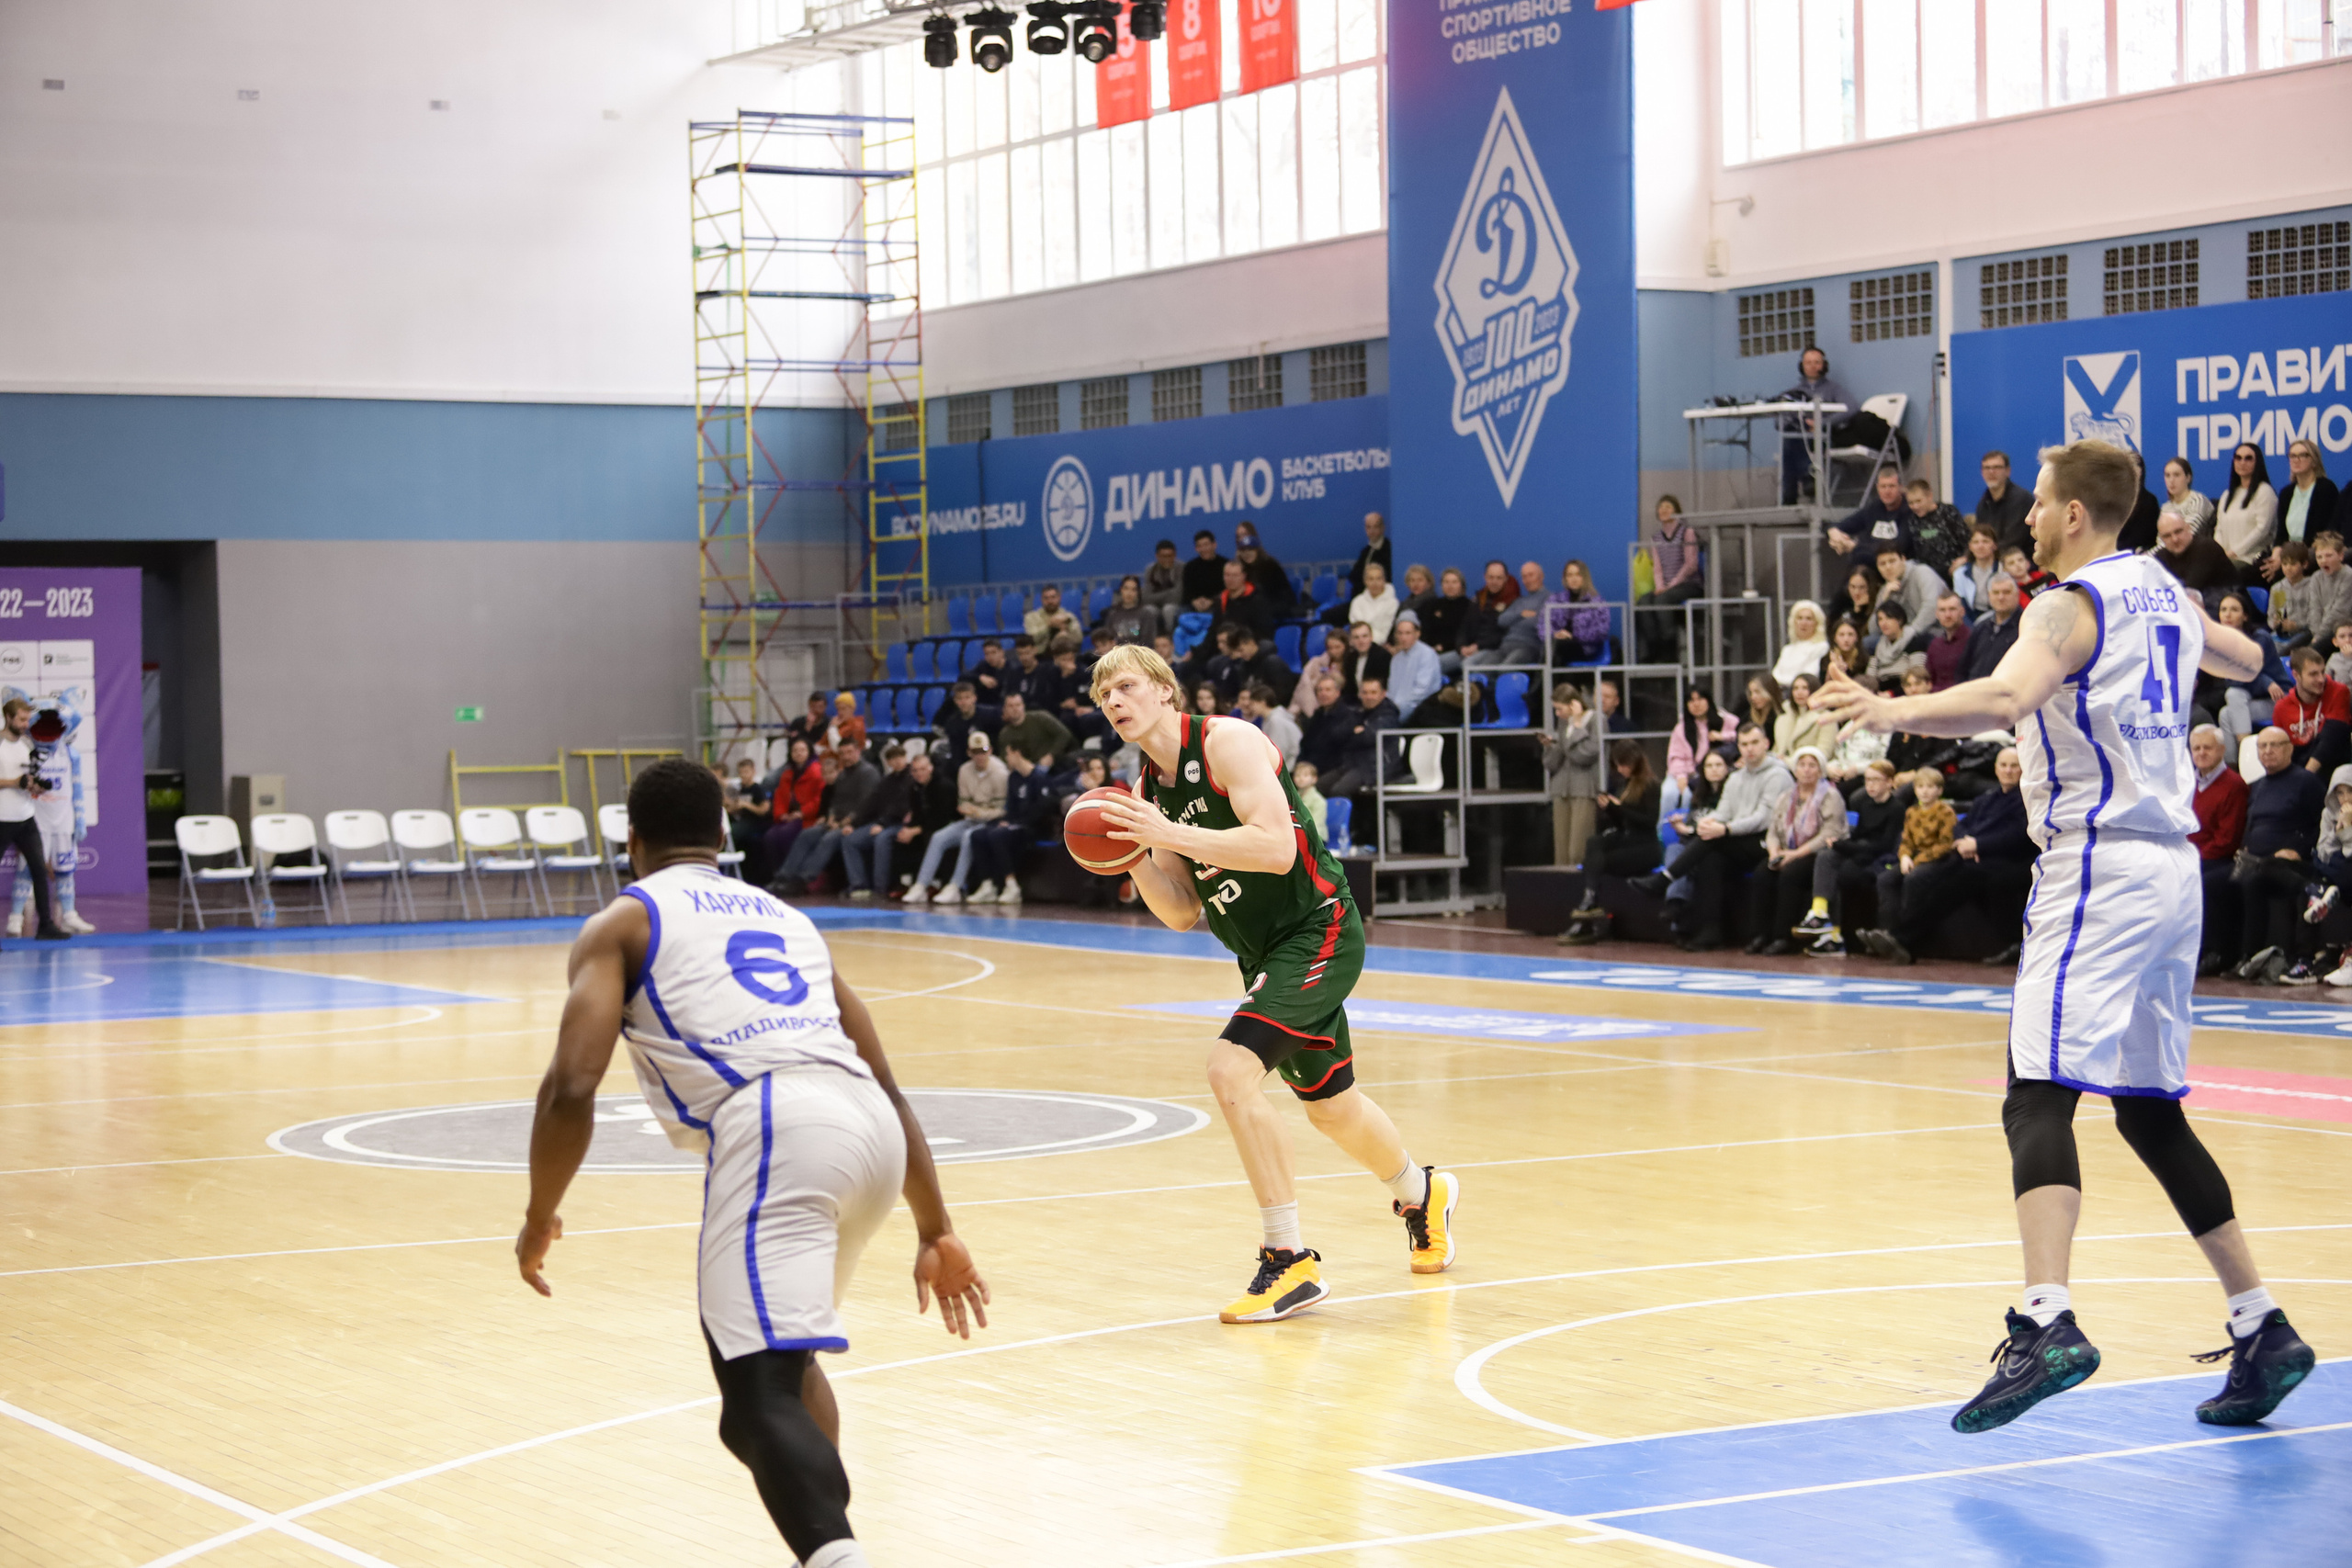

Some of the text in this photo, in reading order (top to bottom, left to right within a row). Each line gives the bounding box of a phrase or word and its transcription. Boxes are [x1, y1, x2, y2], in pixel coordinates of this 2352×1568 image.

[1441, 0, 1572, 39] СПОРТИВНОЕ
[1452, 21, 1561, 64] ОБЩЕСТВО
[1463, 347, 1559, 414] ДИНАМО
[1496, 395, 1521, 418] ЛЕТ
[2177, 403, 2352, 461] ПРИМО
[1104, 457, 1274, 533] ДИНАМО
[1282, 478, 1326, 502] КЛУБ
[725, 930, 809, 1006] 6
